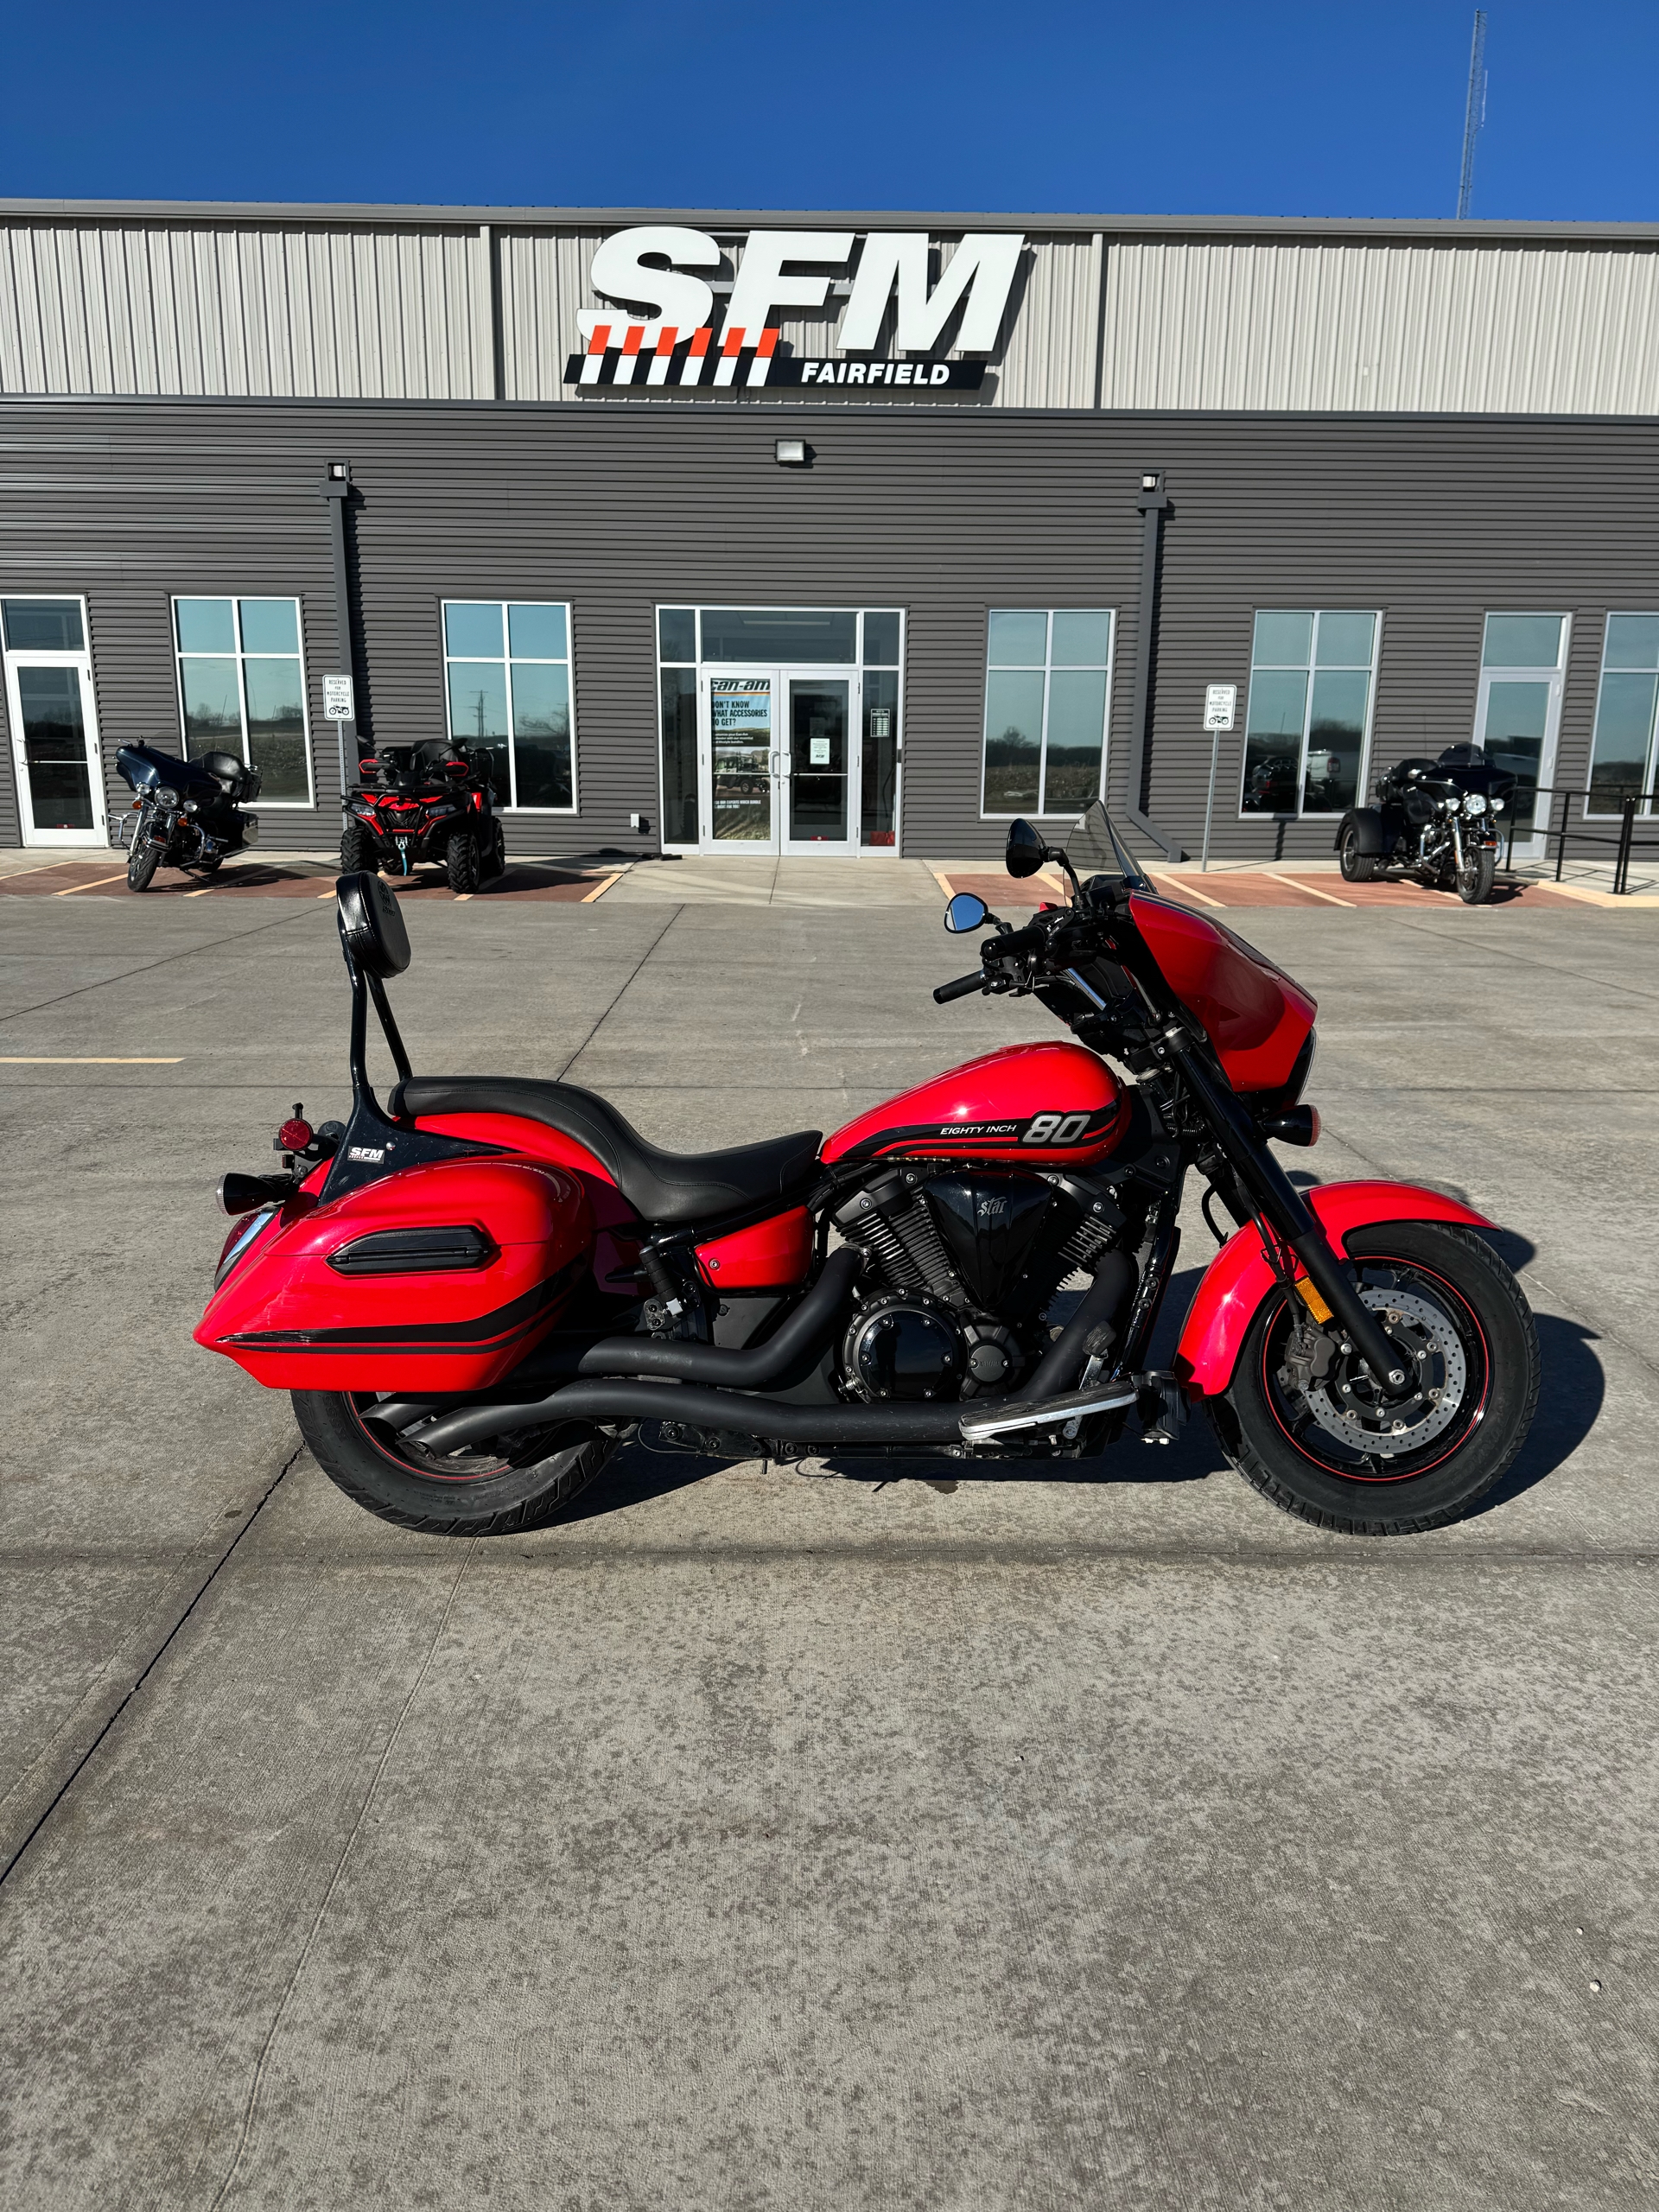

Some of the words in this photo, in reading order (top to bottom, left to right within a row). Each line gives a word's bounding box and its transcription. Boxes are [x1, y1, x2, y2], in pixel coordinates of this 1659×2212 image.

[575, 226, 1026, 352] SFM
[801, 361, 950, 385] FAIRFIELD
[940, 1126, 984, 1135] EIGHTY
[986, 1124, 1018, 1134] INCH
[1022, 1115, 1091, 1144] 80
[349, 1147, 384, 1159] SFM
